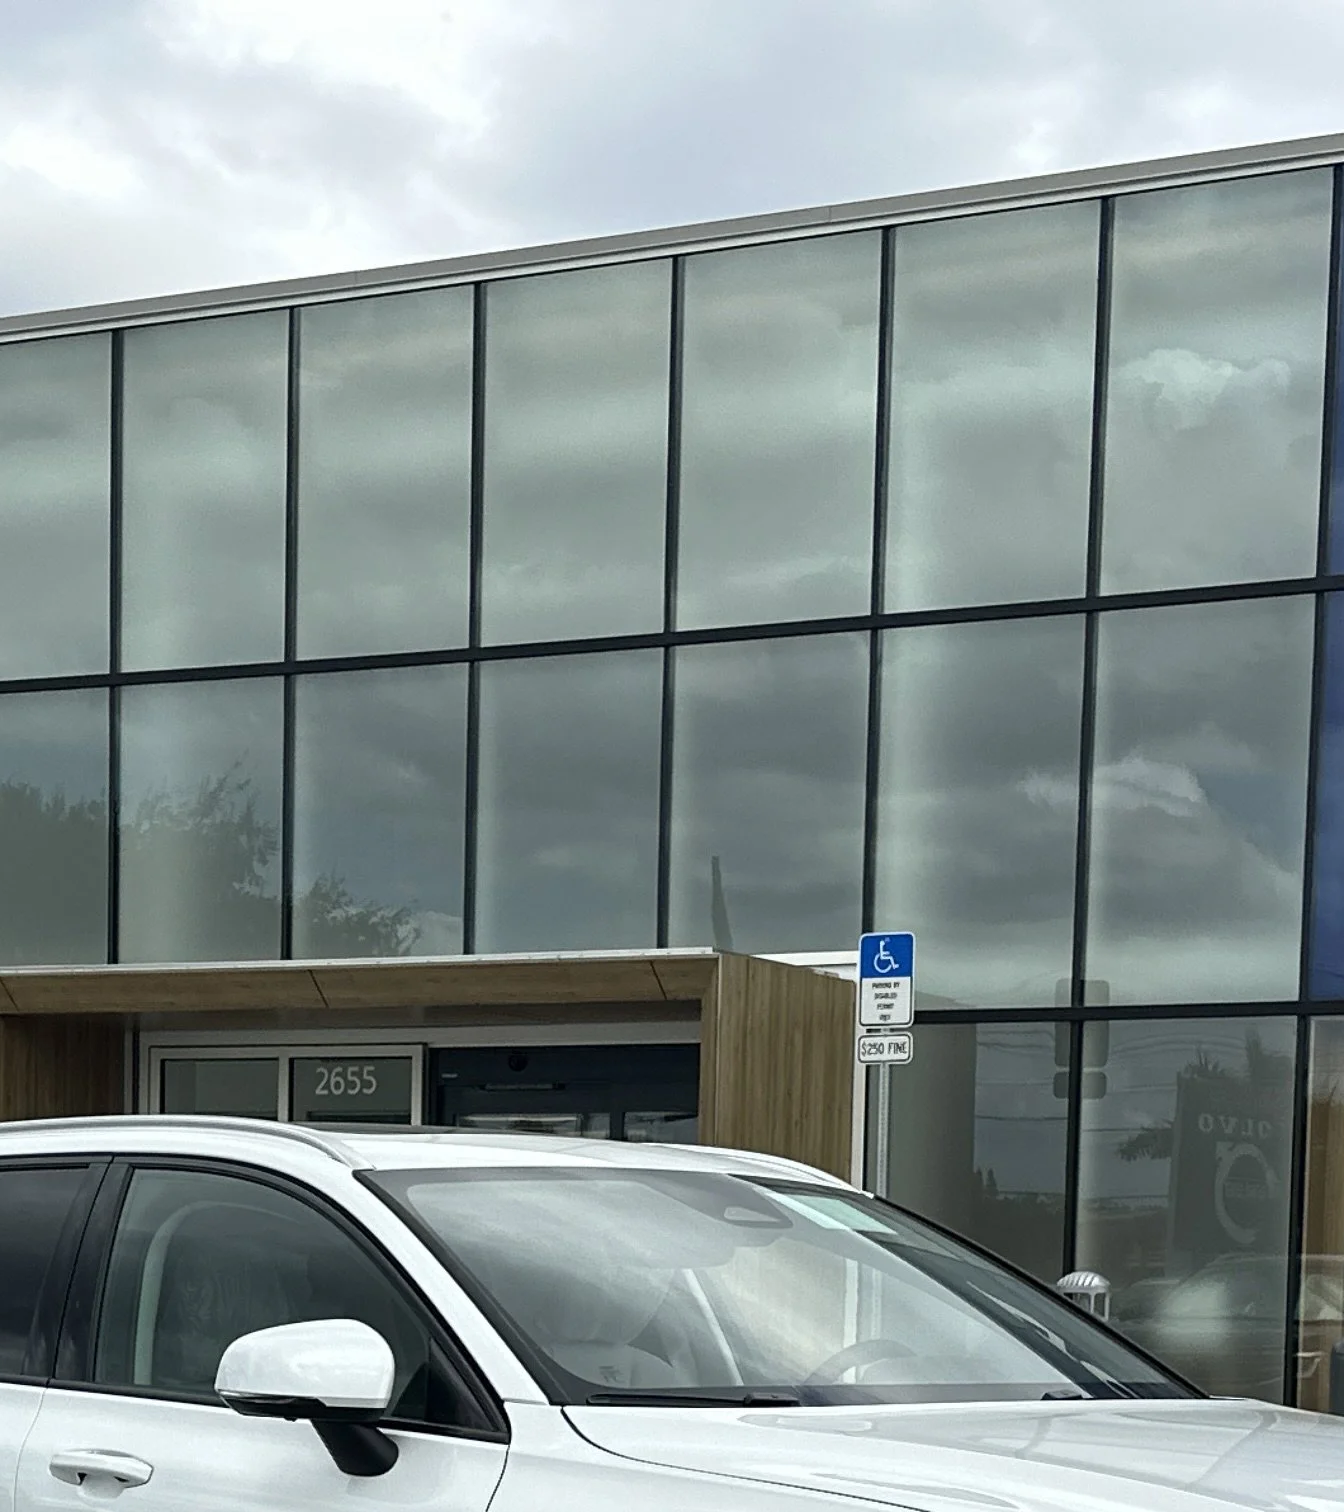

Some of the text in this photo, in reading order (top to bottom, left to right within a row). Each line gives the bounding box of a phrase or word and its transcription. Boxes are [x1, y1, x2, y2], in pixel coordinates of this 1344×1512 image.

[861, 1040, 908, 1057] $250 FINE
[315, 1066, 377, 1096] 2655
